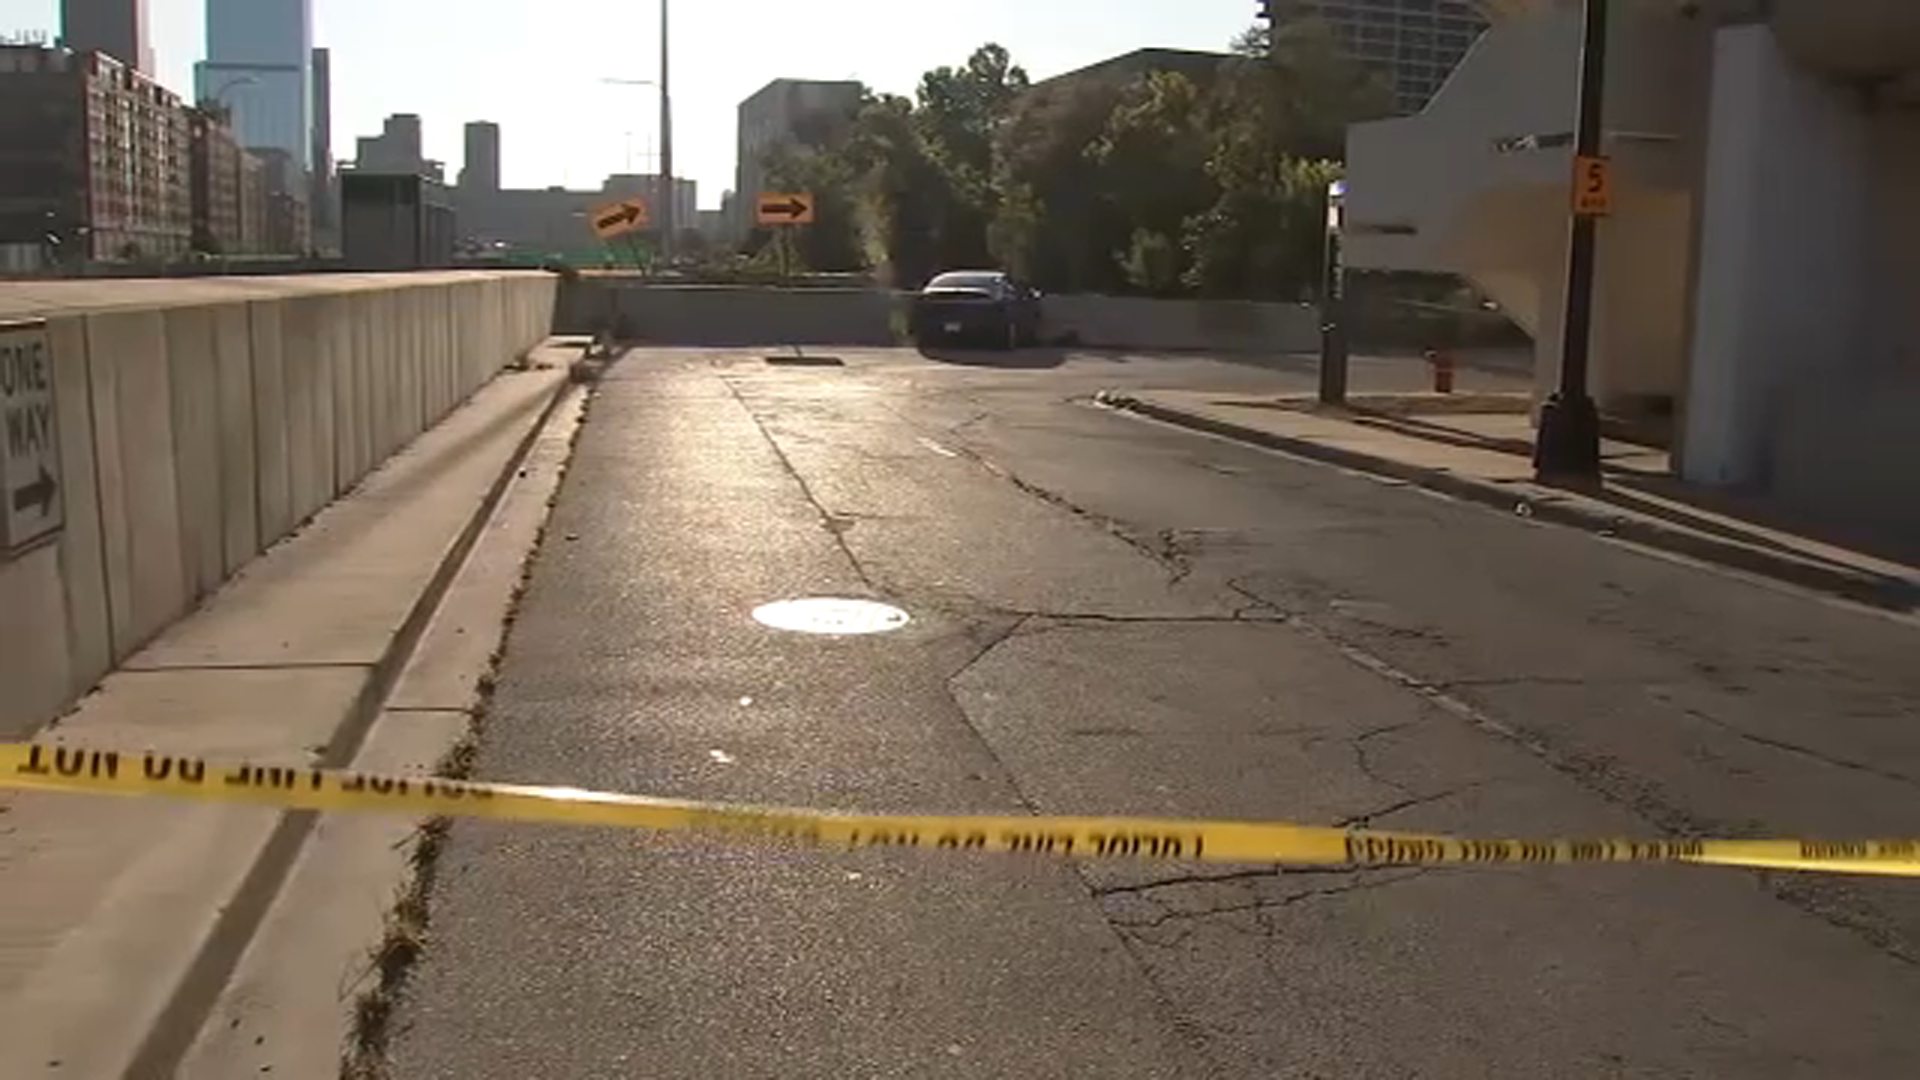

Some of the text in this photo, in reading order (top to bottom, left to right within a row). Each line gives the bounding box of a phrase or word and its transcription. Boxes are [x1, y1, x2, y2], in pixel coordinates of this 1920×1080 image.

[1588, 162, 1604, 194] 5
[0, 341, 46, 397] ONE
[5, 403, 51, 458] WAY
[17, 745, 120, 780] NOT
